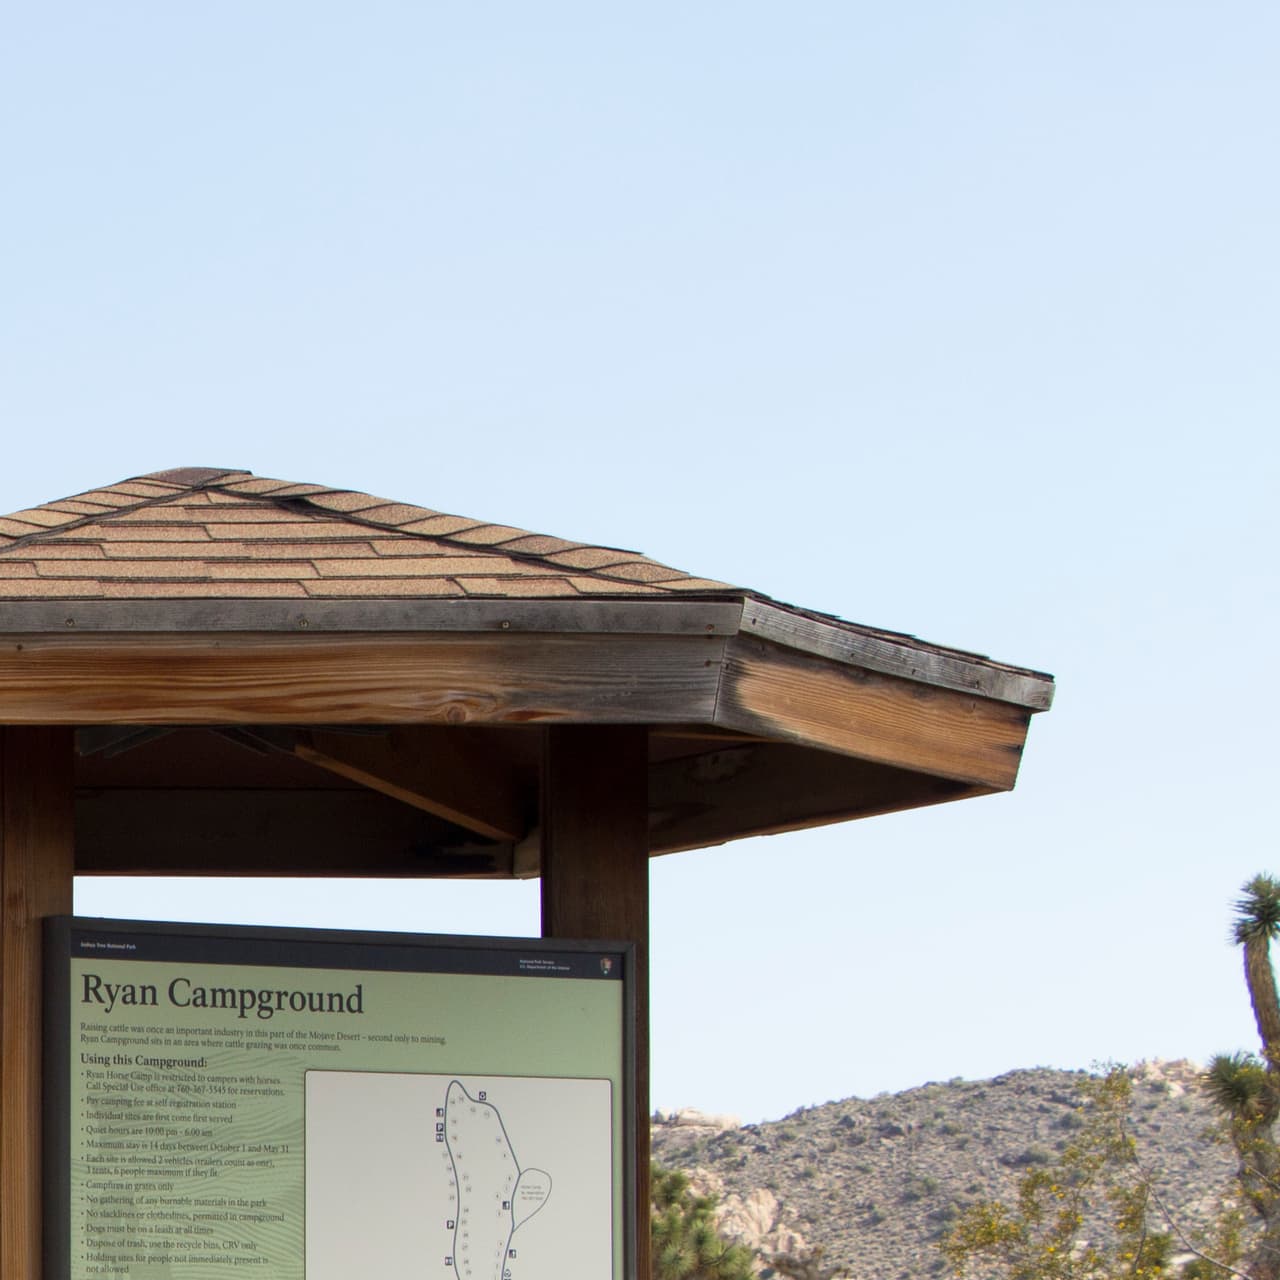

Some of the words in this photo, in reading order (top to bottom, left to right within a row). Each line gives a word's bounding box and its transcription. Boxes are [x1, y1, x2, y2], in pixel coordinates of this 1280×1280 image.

[81, 973, 158, 1012] Ryan
[168, 977, 363, 1018] Campground
[79, 1021, 108, 1035] Raising
[108, 1023, 129, 1032] cattle
[130, 1025, 144, 1033] was
[145, 1025, 163, 1034] once
[164, 1026, 174, 1034] an
[175, 1025, 212, 1038] important
[213, 1026, 243, 1039] industry
[245, 1028, 253, 1038] in
[254, 1028, 268, 1038] this
[269, 1030, 284, 1040] part
[285, 1028, 294, 1041] of
[295, 1029, 307, 1039] the
[308, 1030, 335, 1040] Mojave
[336, 1031, 360, 1040] Desert
[367, 1032, 393, 1042] second
[393, 1032, 410, 1044] only
[410, 1034, 419, 1043] to
[420, 1034, 445, 1046] mining.
[79, 1034, 99, 1045] Ryan
[99, 1034, 149, 1047] Campground
[149, 1036, 163, 1045] sits
[163, 1036, 172, 1046] in
[172, 1038, 182, 1046] an
[183, 1038, 199, 1047] area
[200, 1037, 223, 1048] where
[224, 1038, 244, 1048] cattle
[245, 1039, 272, 1051] grazing
[273, 1042, 288, 1050] was
[288, 1042, 306, 1050] once
[307, 1043, 341, 1051] common.
[80, 1052, 111, 1068] Using
[112, 1053, 132, 1065] this
[134, 1054, 208, 1070] Campground:
